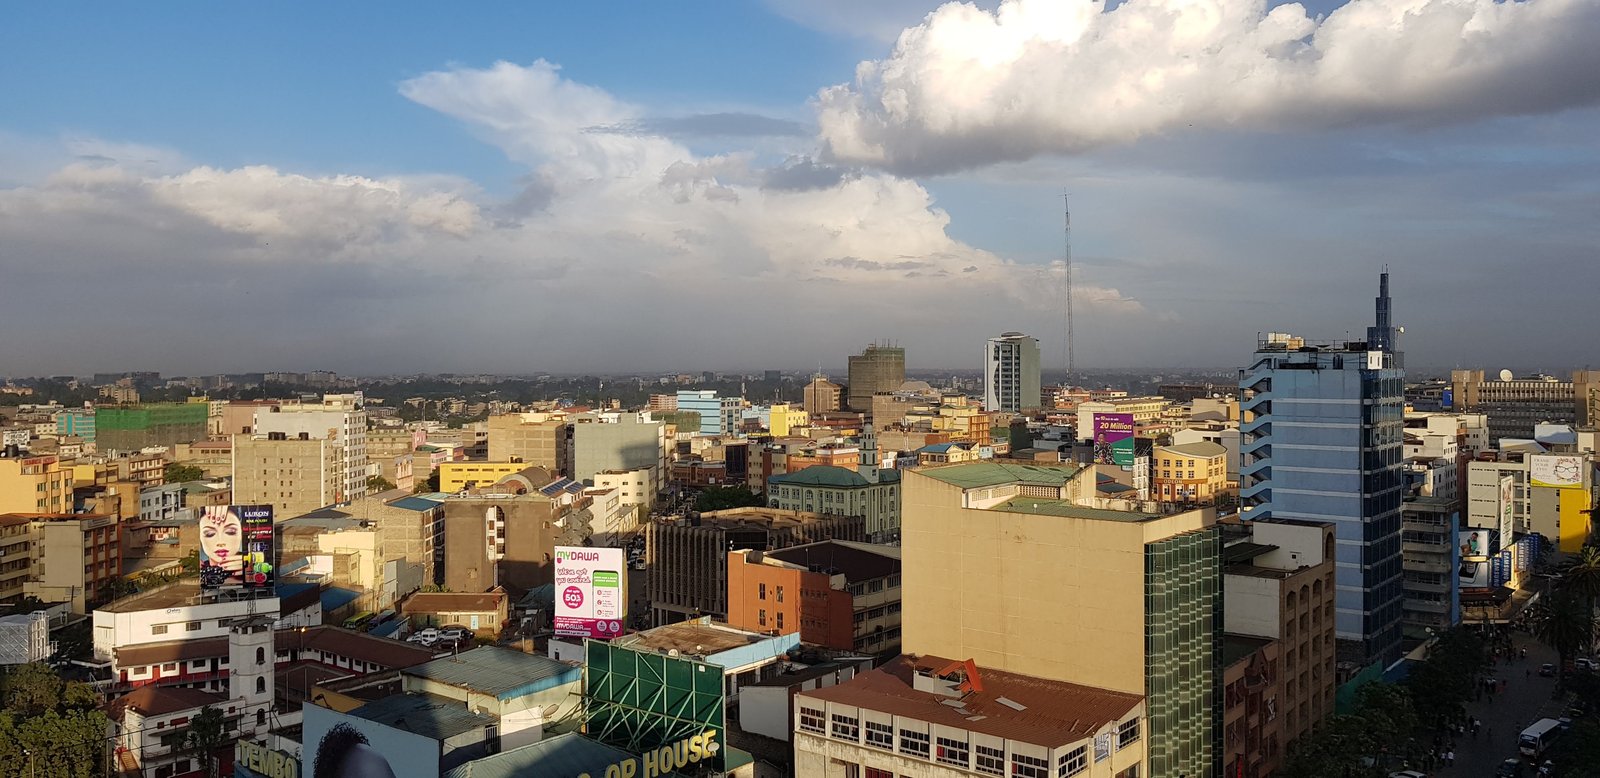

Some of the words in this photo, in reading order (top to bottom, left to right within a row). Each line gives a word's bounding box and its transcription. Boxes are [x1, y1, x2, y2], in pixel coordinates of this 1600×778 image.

[1110, 422, 1132, 430] Million
[557, 551, 600, 562] MYDAWA
[238, 739, 298, 778] TEMBO
[642, 729, 717, 778] HOUSE
